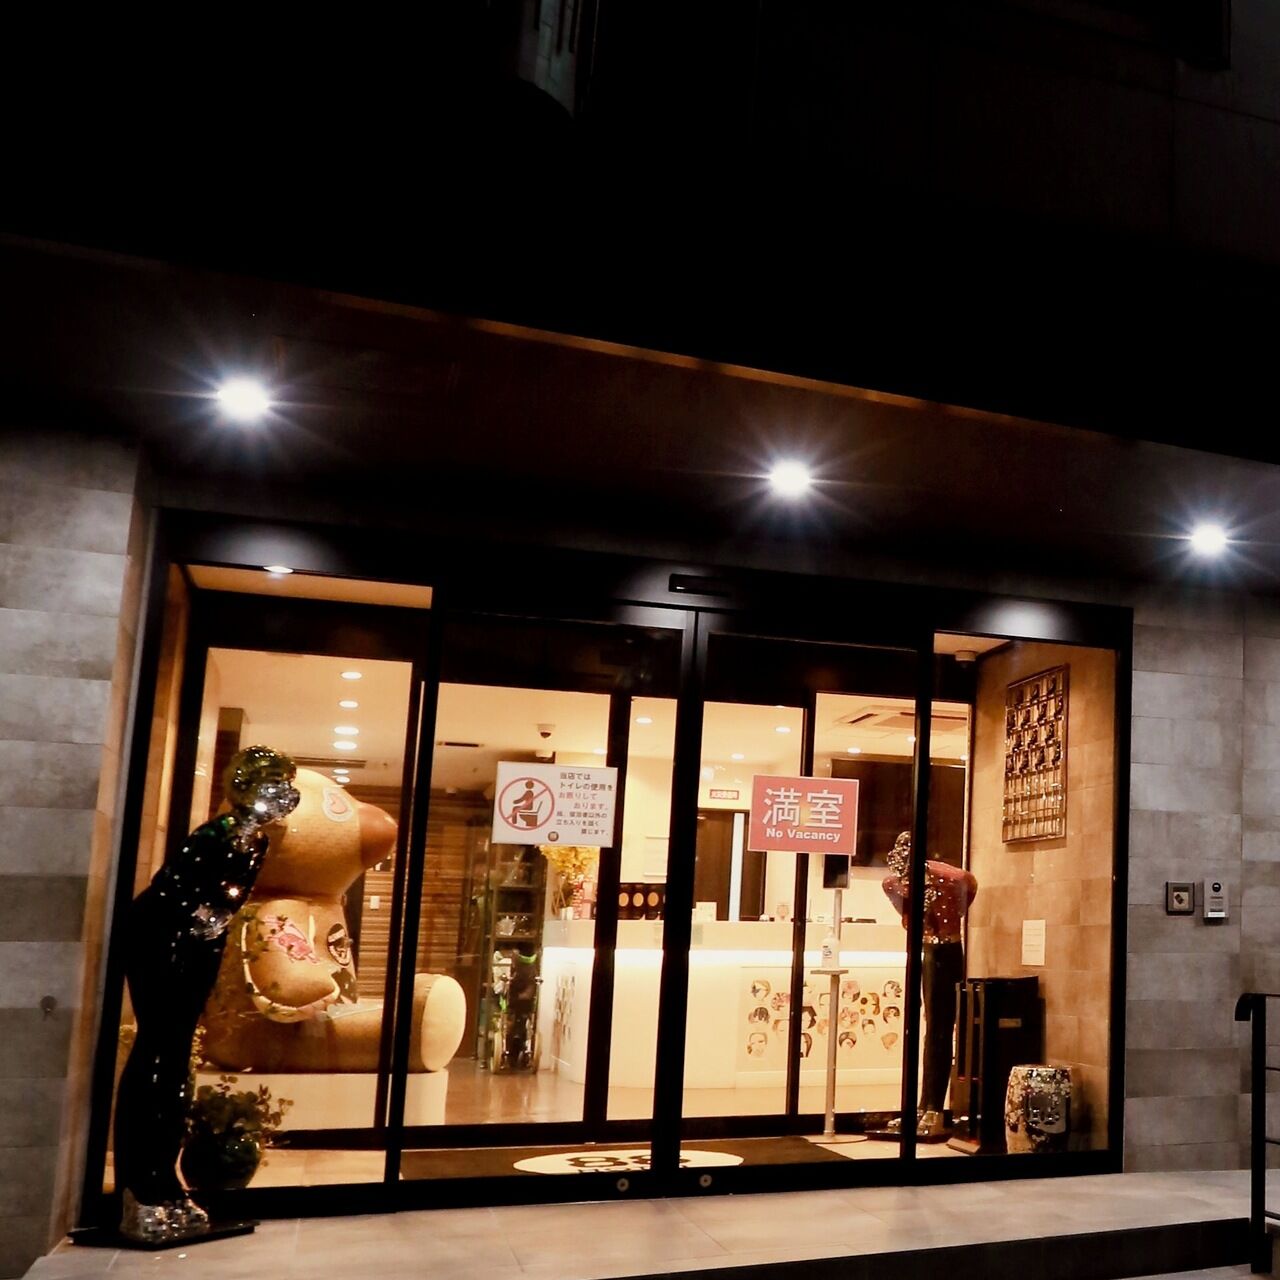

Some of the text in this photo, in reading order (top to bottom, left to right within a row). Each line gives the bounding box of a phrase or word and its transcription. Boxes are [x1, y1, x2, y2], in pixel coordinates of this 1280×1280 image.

[762, 787, 843, 829] 満室
[766, 828, 841, 843] No Vacancy
